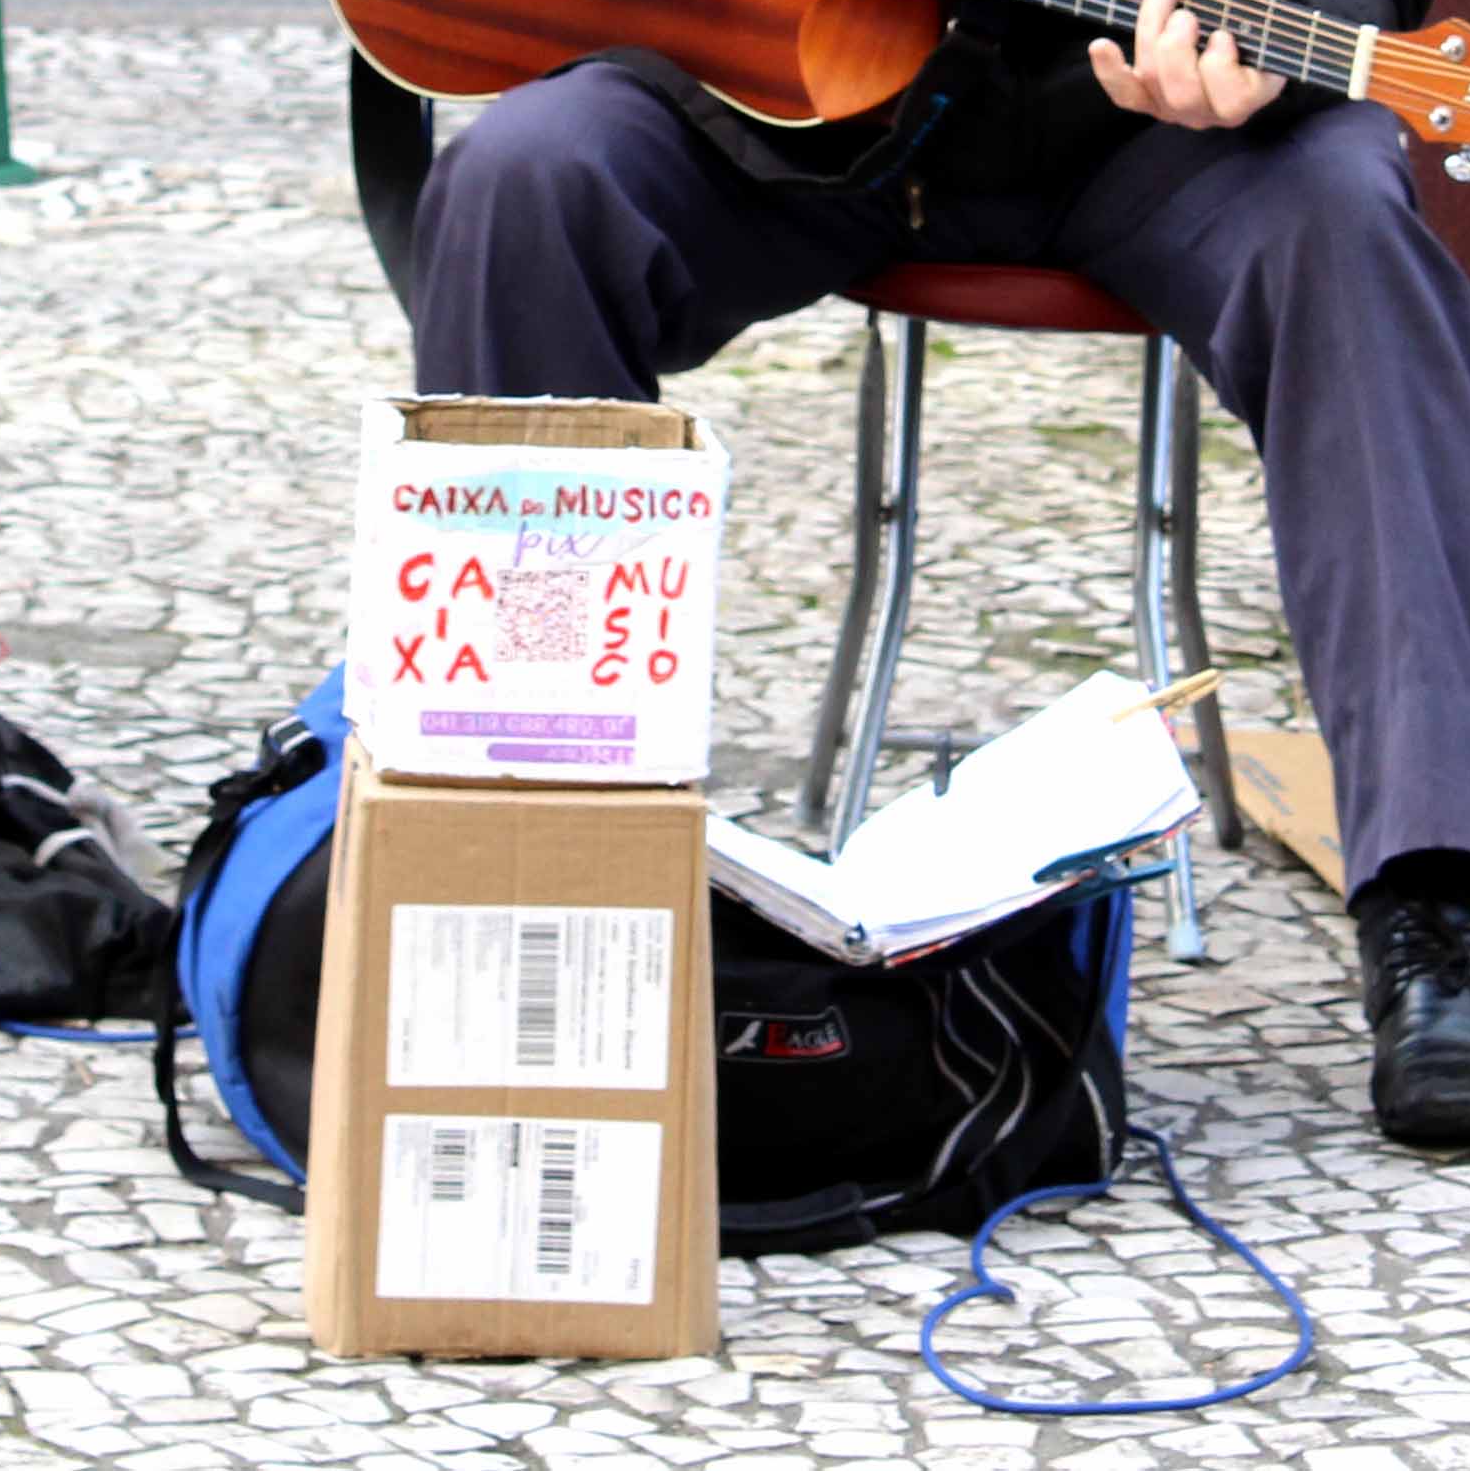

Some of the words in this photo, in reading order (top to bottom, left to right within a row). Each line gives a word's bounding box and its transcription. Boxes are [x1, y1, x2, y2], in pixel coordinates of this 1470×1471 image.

[393, 484, 508, 518] CAIXA
[554, 484, 712, 523] MUSICO
[513, 520, 601, 567] pix
[764, 1022, 842, 1056] EAGLE
